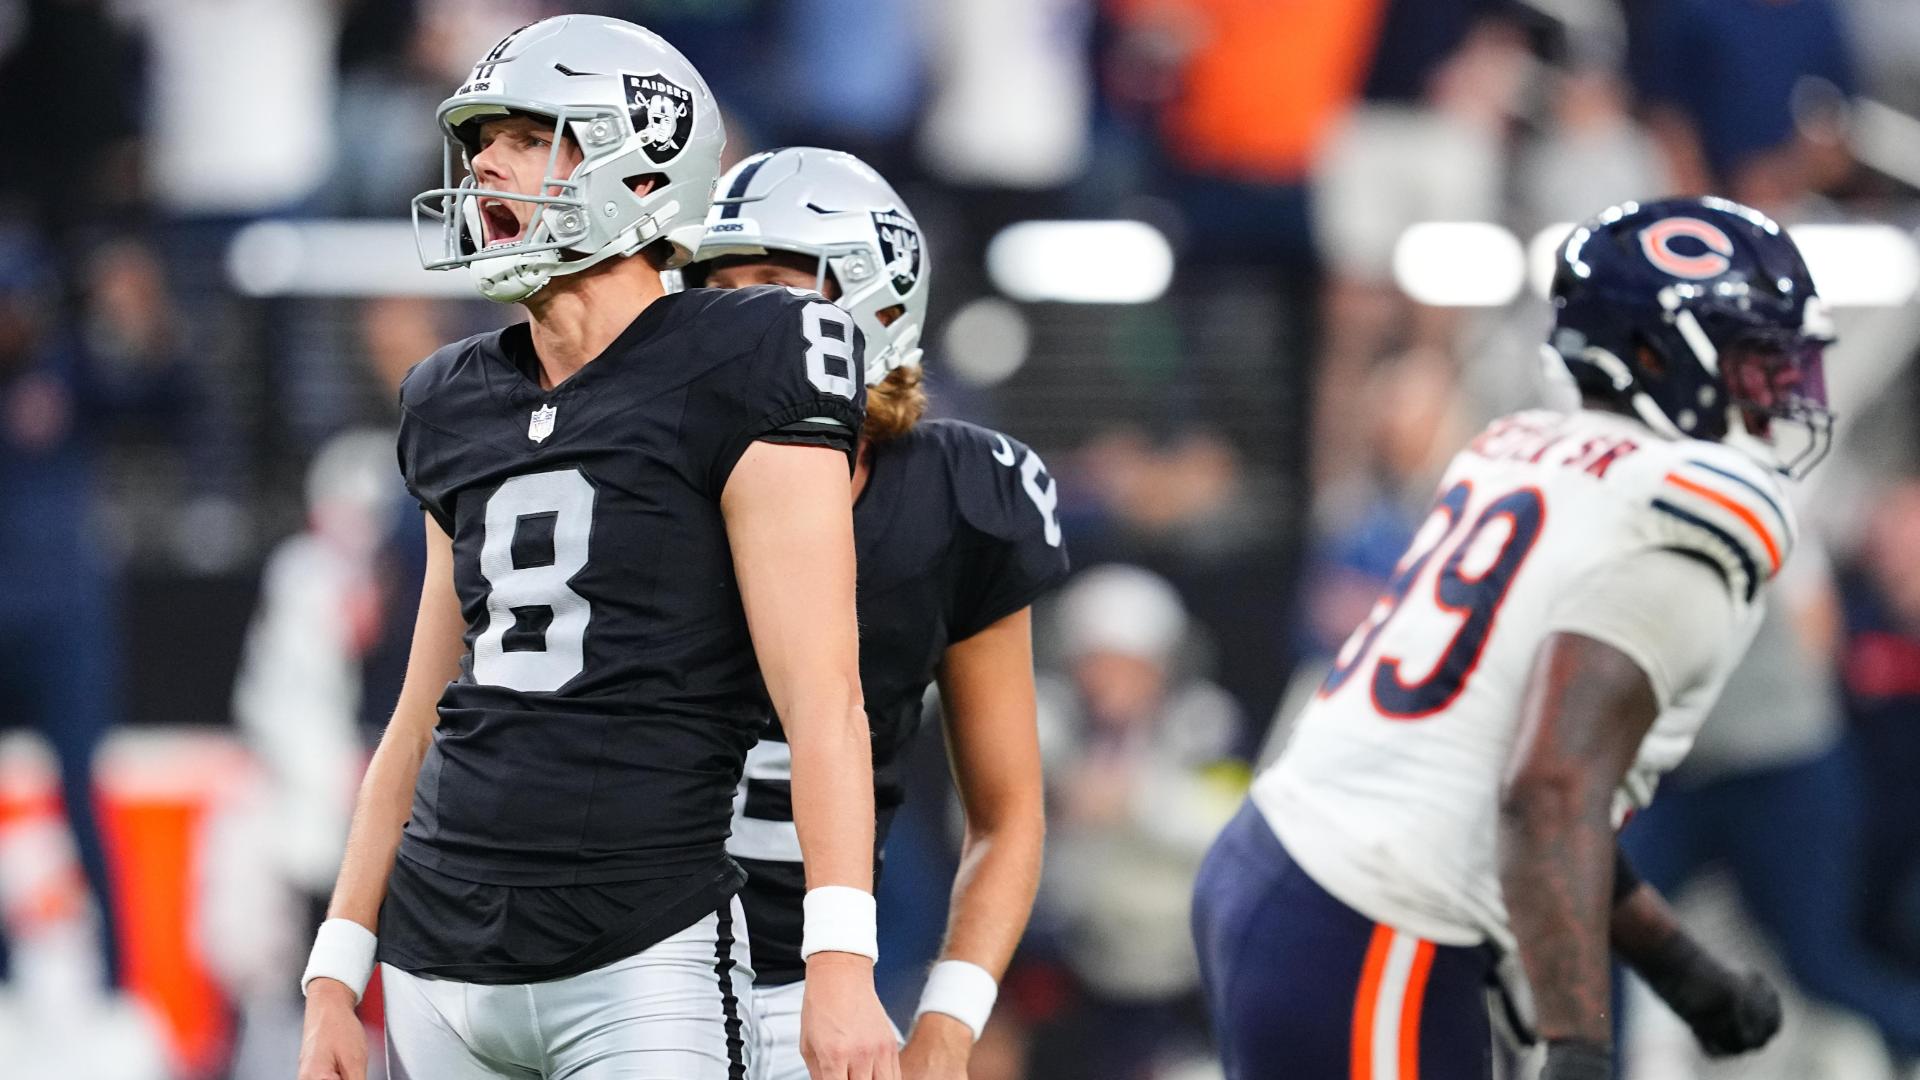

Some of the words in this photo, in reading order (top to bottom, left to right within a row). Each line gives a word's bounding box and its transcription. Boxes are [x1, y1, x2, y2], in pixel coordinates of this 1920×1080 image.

[630, 77, 689, 101] RAIDERS
[1639, 216, 1735, 280] C
[801, 301, 857, 401] 8
[473, 468, 596, 694] 8
[1316, 479, 1548, 722] 99
